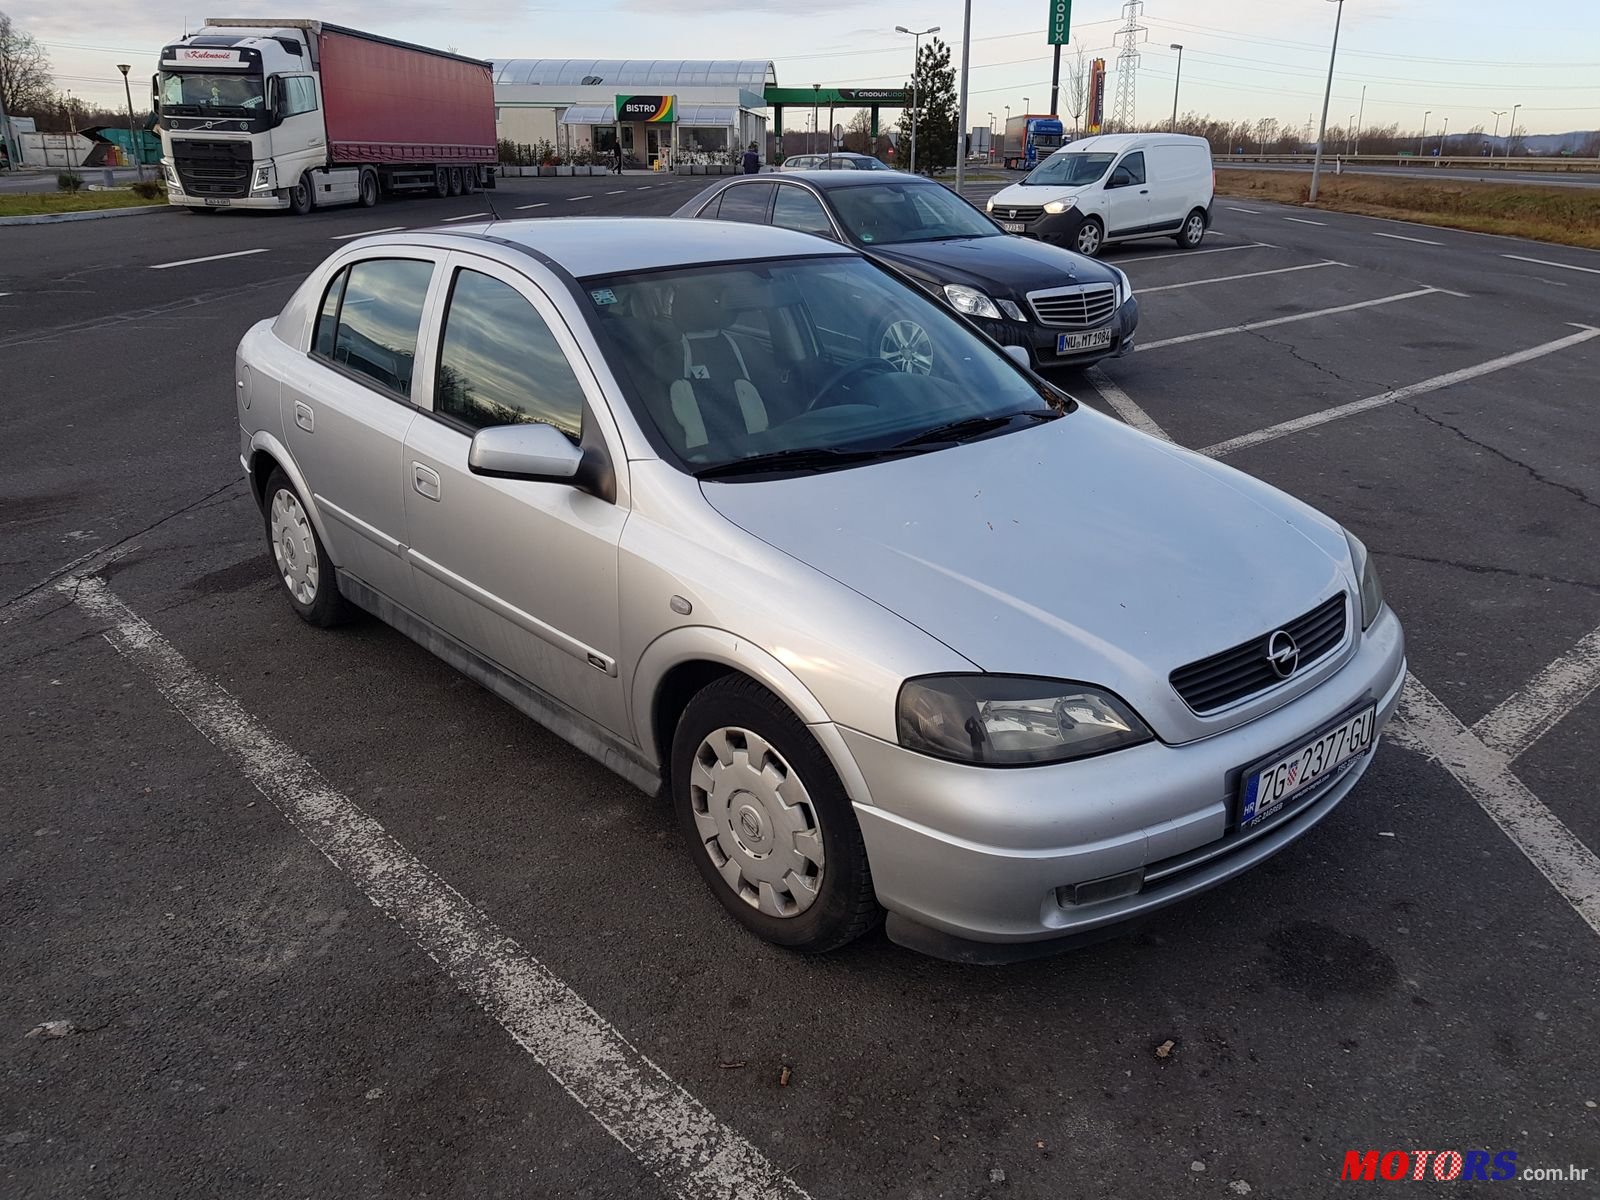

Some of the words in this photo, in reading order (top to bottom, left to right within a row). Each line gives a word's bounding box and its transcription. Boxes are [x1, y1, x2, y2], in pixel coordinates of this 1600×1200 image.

[1055, 0, 1065, 41] ODUX
[626, 104, 656, 112] BISTRO
[1065, 334, 1077, 350] NU
[1081, 333, 1092, 347] MT
[1093, 330, 1110, 345] 1984
[1258, 762, 1287, 810] ZG
[1243, 802, 1255, 816] HR
